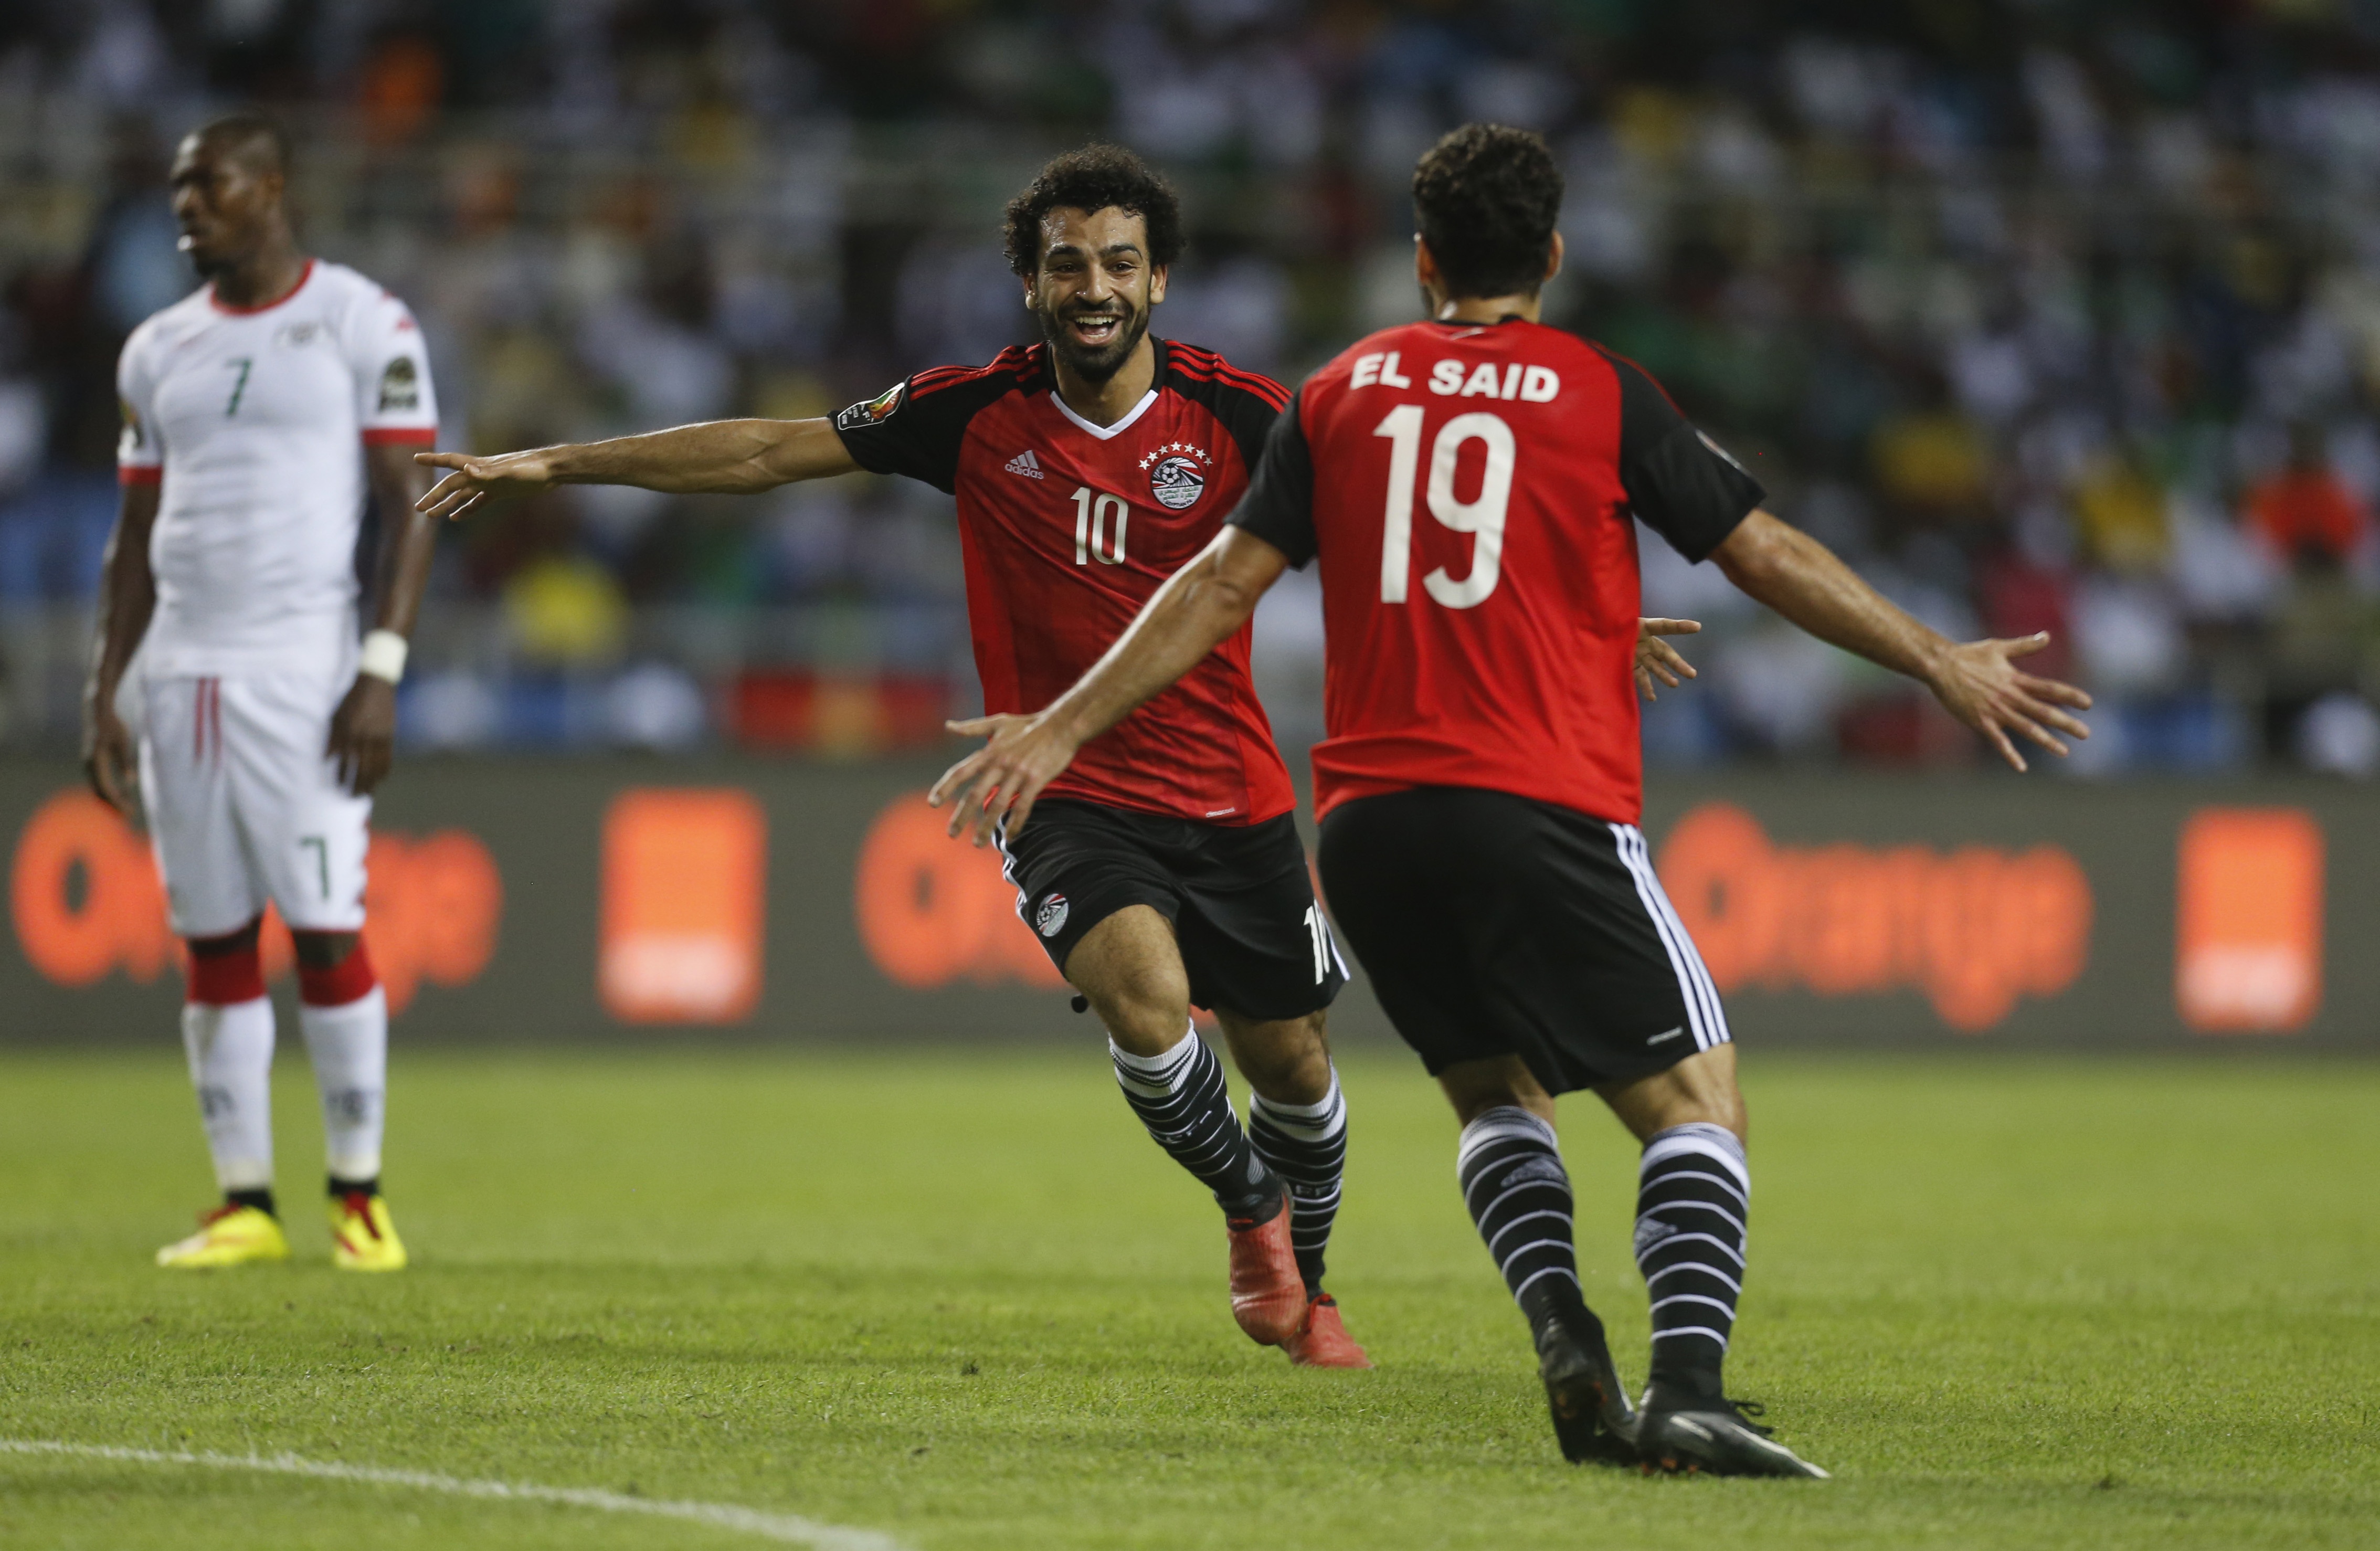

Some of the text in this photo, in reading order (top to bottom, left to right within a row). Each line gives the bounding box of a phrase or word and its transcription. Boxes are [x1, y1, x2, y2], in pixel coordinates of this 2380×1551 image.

[224, 356, 252, 416] 7
[1350, 351, 1560, 403] EL SAID
[1004, 463, 1044, 480] adidas
[1070, 487, 1128, 565] 10
[1372, 404, 1516, 609] 19
[299, 836, 330, 900] 7
[1658, 802, 2093, 1032] Orange
